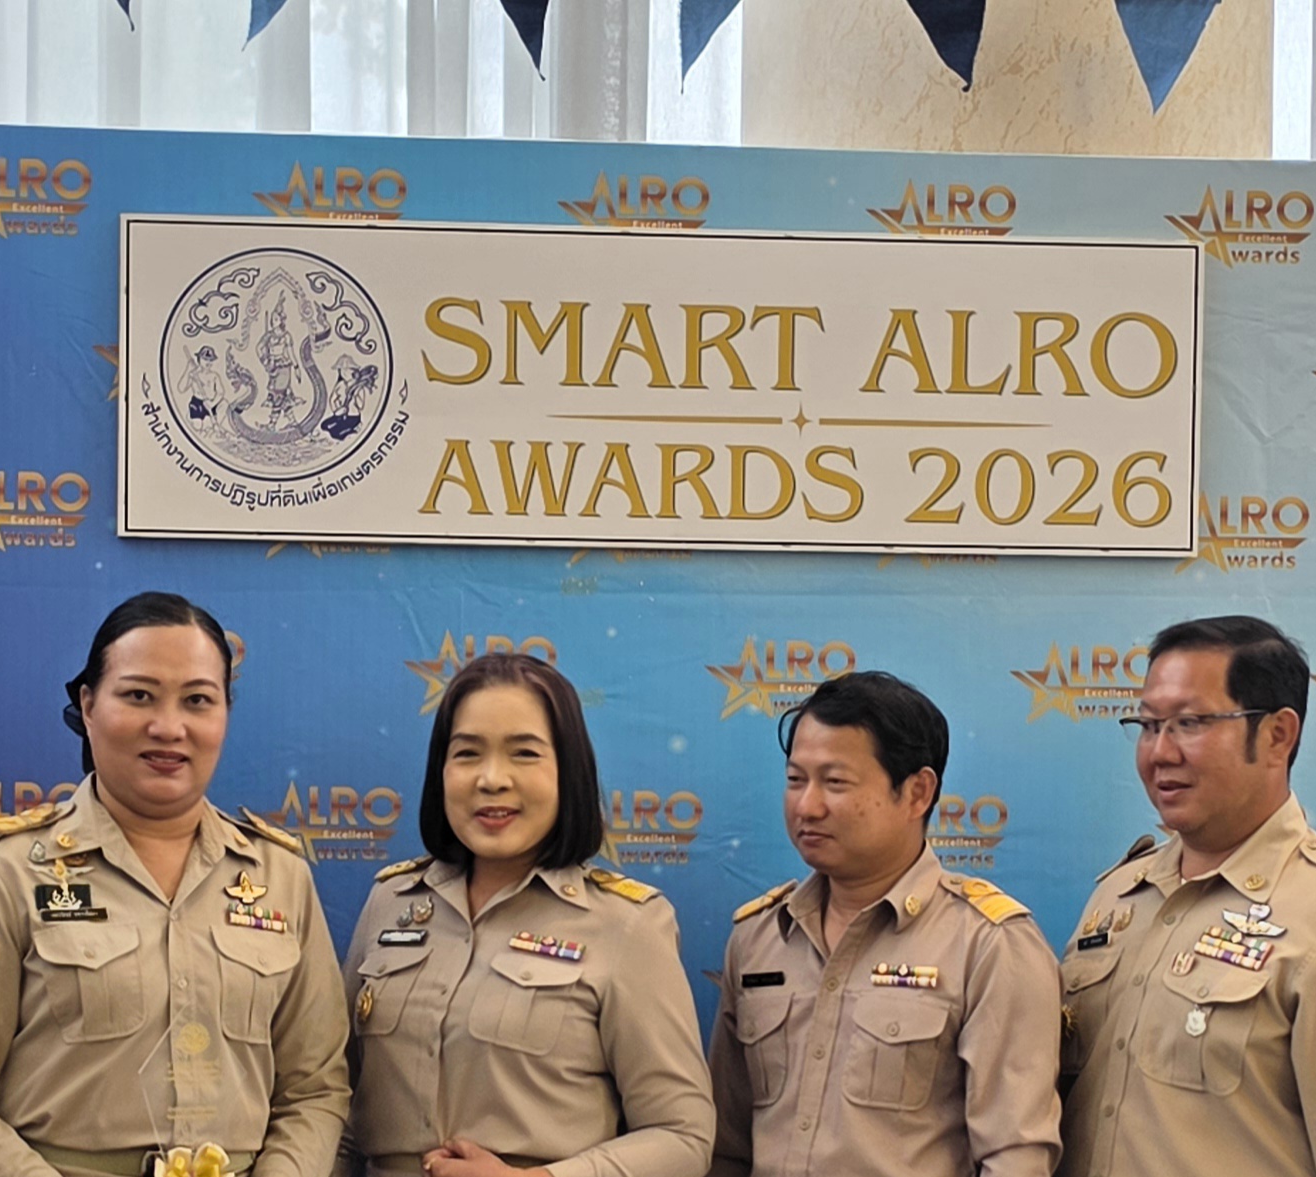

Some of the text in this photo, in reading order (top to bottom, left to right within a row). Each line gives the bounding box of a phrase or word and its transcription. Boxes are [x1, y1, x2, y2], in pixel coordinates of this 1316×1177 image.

[11, 203, 64, 214] Excellent
[252, 160, 406, 216] ALRO
[557, 169, 710, 225] ALRO
[865, 179, 1016, 235] ALRO
[1163, 184, 1314, 240] ALRO
[1238, 233, 1287, 243] Excellent
[420, 296, 1179, 399] SMART ALRO
[141, 401, 410, 511] สำนักงานการปฏิรูปที่ดินเพื่อเกษตรกรรม
[418, 439, 1172, 527] AWARDS 2026
[11, 515, 63, 525] Excellent
[1234, 539, 1284, 548] Excellent
[705, 635, 856, 691] ALRO
[779, 684, 817, 694] Excelle
[1084, 689, 1134, 698] Excellent
[268, 780, 402, 836] ALRO
[609, 789, 703, 831] LRO
[939, 796, 1008, 834] RO
[323, 830, 374, 840] Excellent
[625, 833, 677, 843] Excellent
